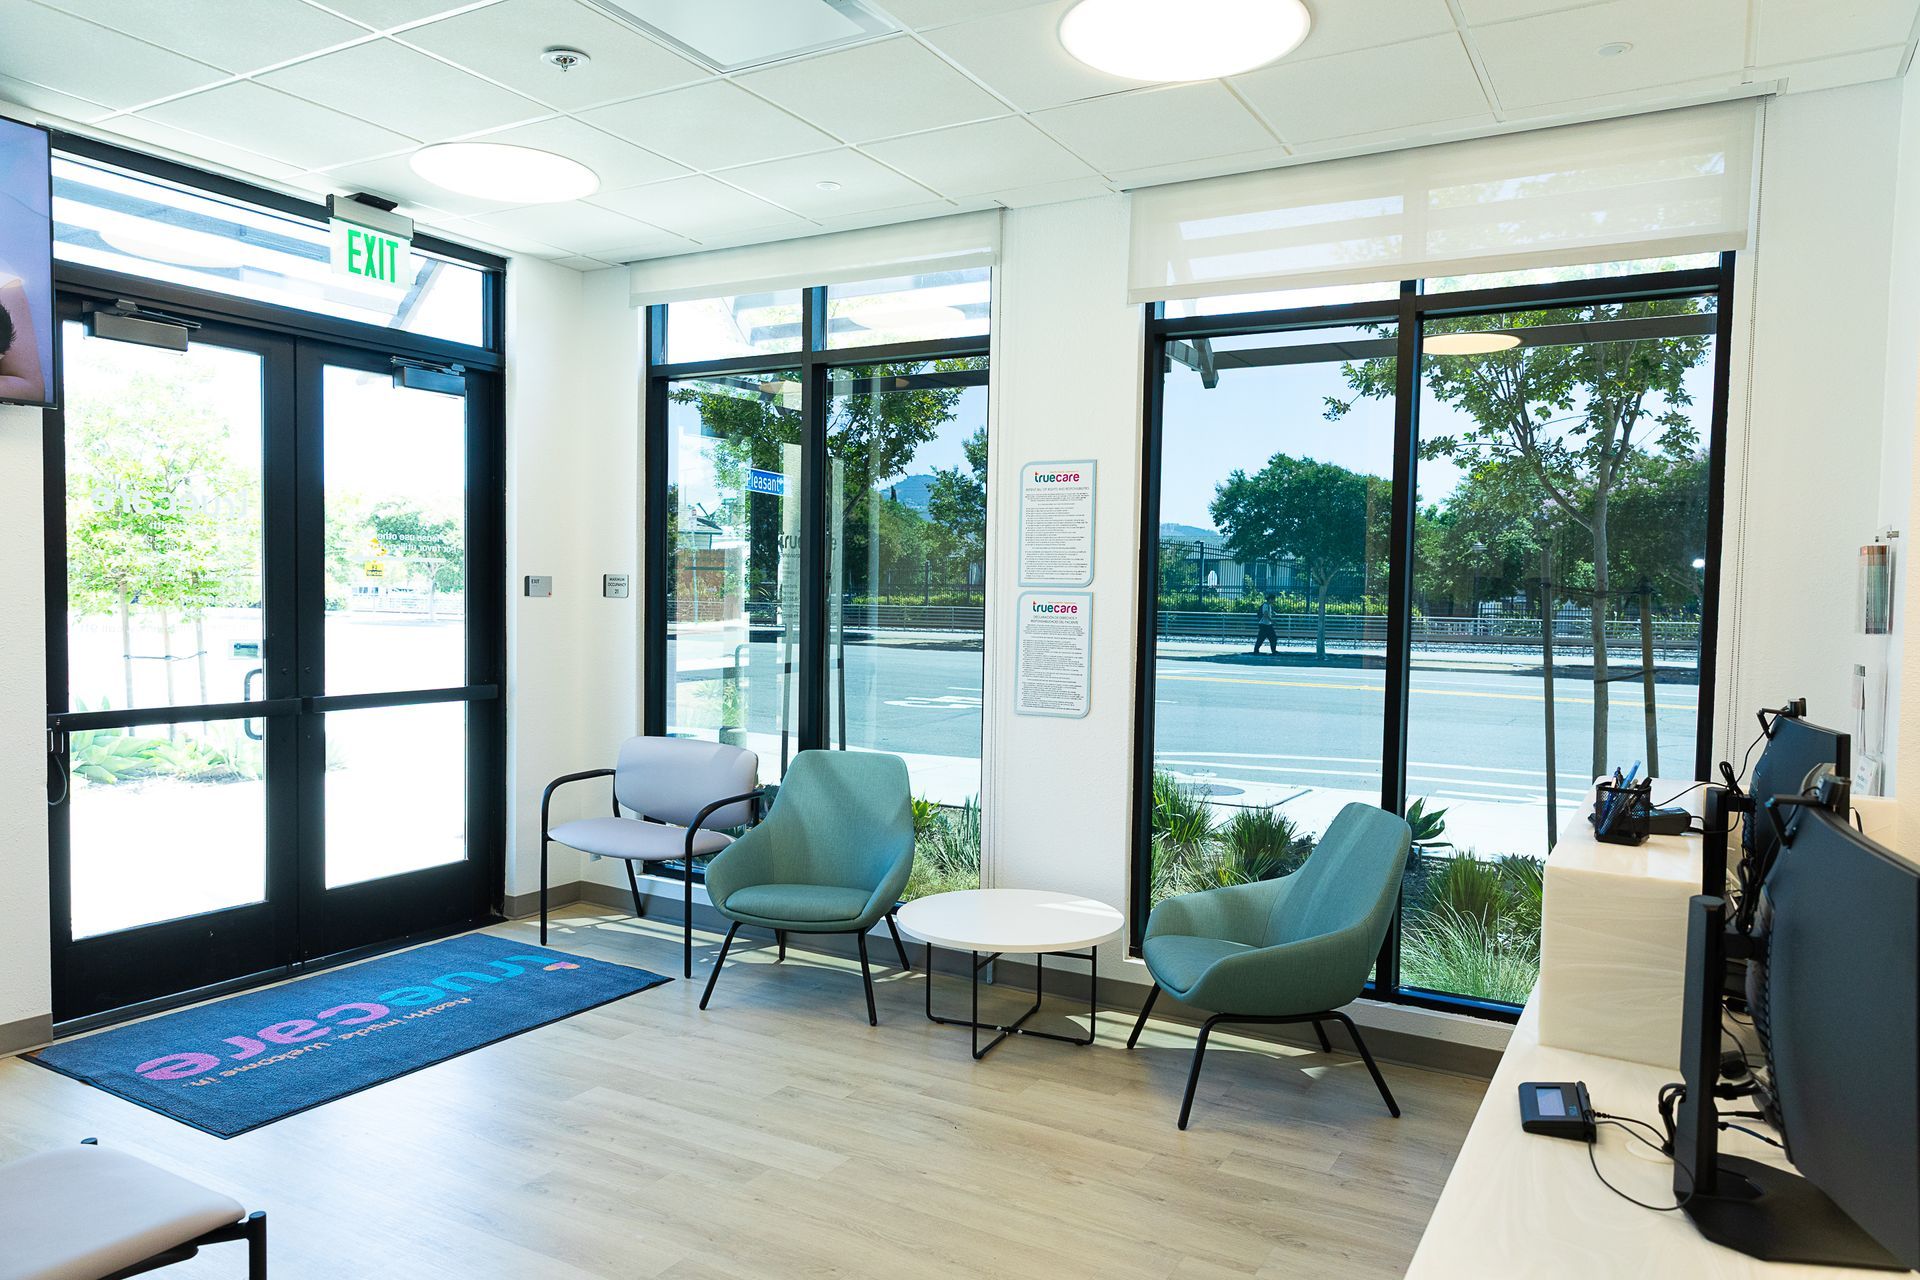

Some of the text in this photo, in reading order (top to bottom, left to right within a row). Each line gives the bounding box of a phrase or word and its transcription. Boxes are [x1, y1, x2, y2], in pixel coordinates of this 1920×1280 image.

[348, 229, 399, 283] EXIT
[746, 469, 780, 492] Pleasant
[1034, 471, 1080, 483] truecare
[1032, 601, 1078, 614] truecare
